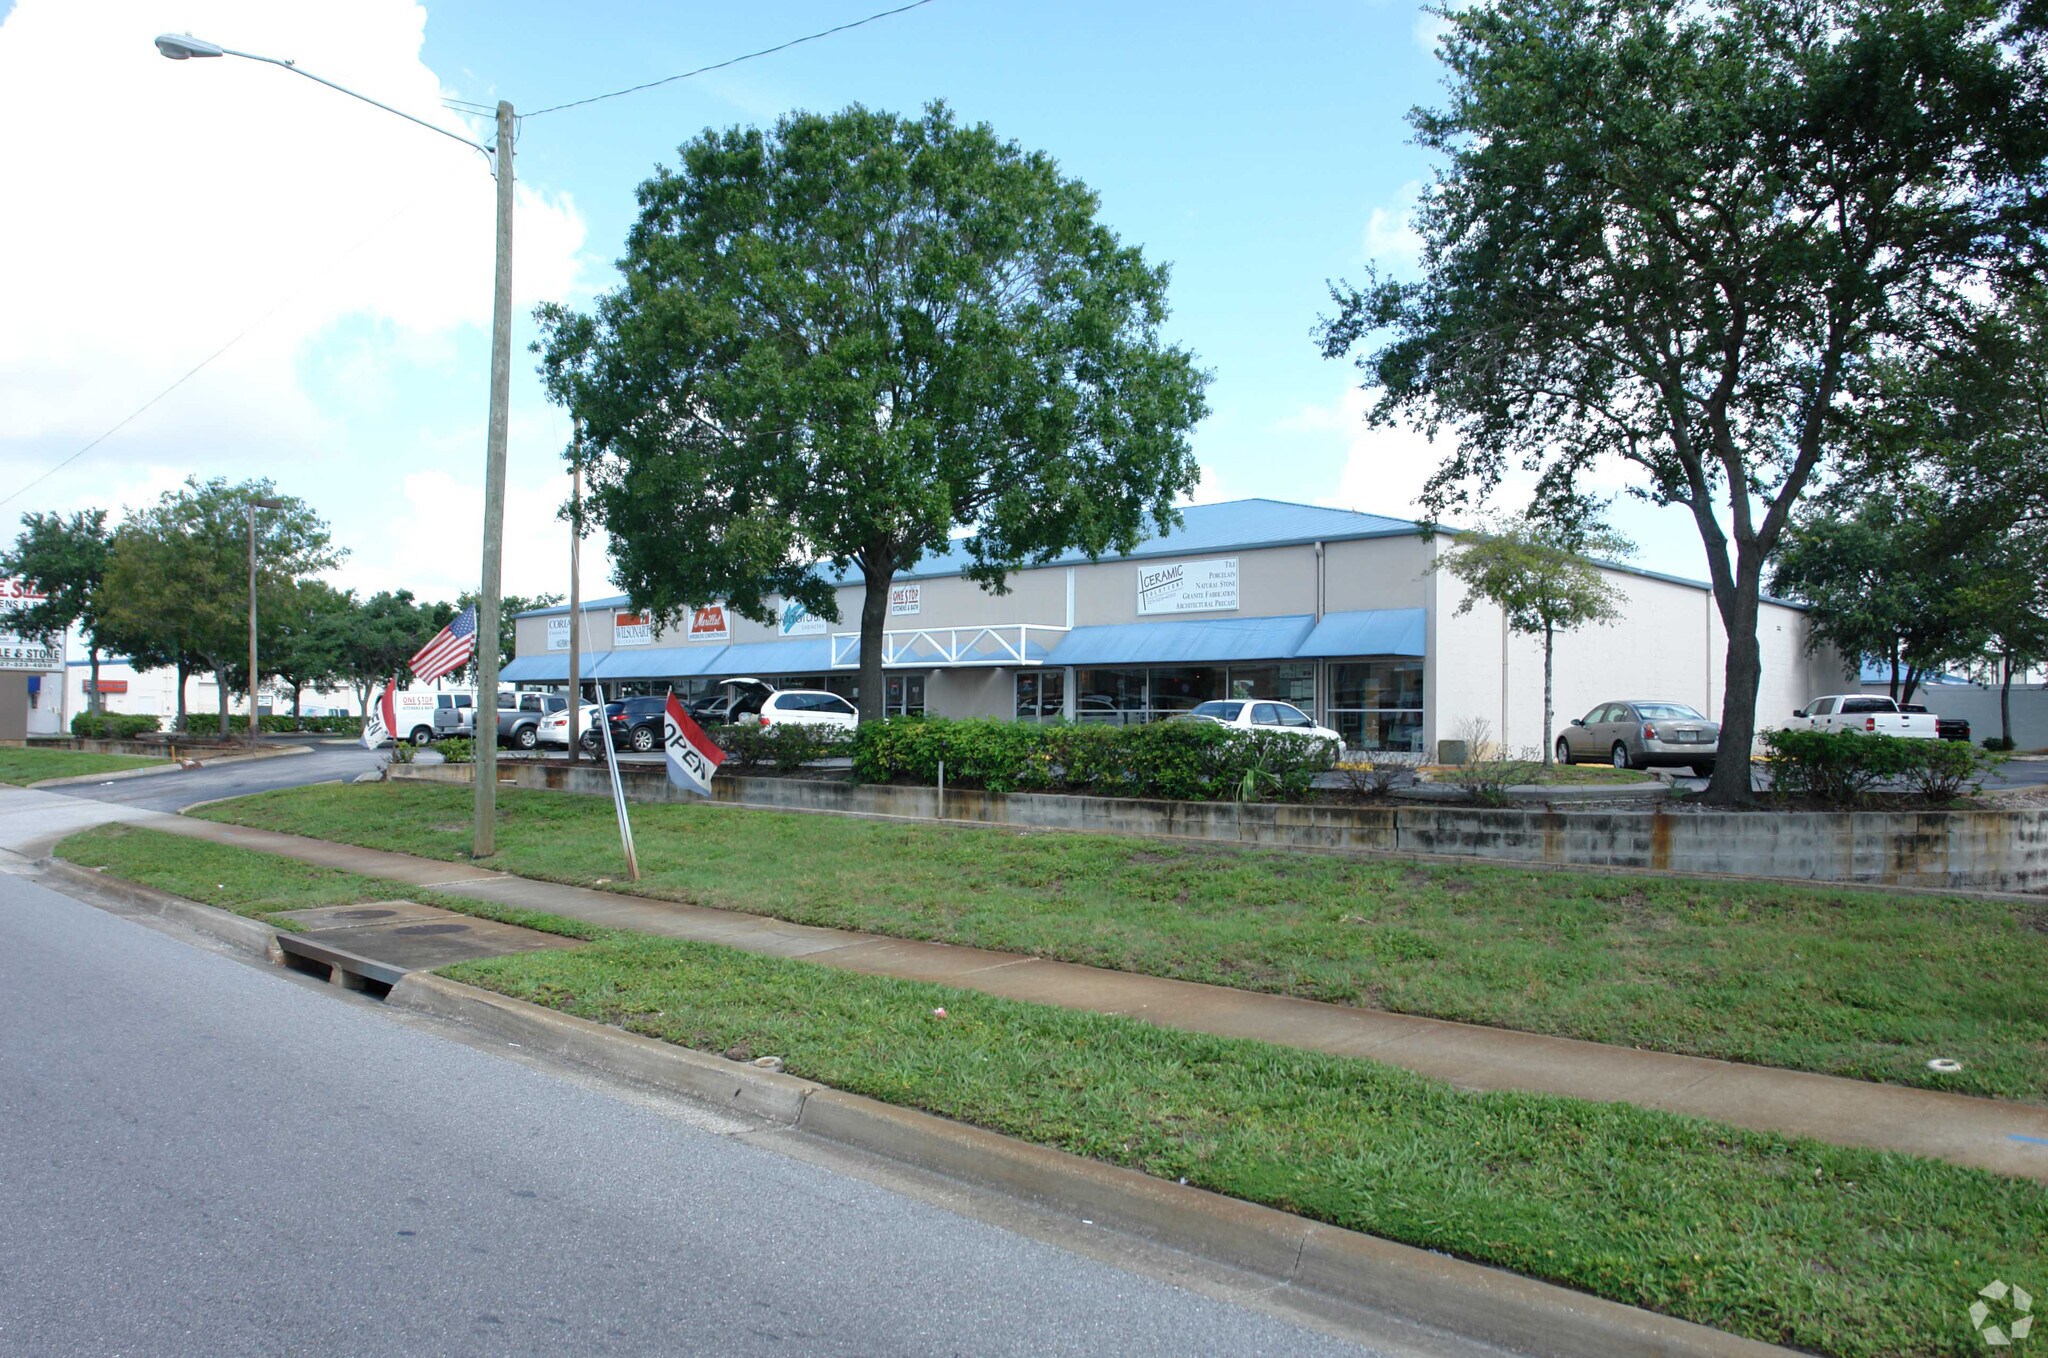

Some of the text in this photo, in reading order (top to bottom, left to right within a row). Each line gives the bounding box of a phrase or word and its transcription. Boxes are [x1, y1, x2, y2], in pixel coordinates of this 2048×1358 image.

[1143, 564, 1183, 588] CERAMIC
[893, 590, 904, 602] ONE
[1182, 592, 1204, 600] GRANITE
[26, 649, 60, 658] STONE
[418, 696, 433, 705] STOP
[665, 723, 706, 780] OPEN
